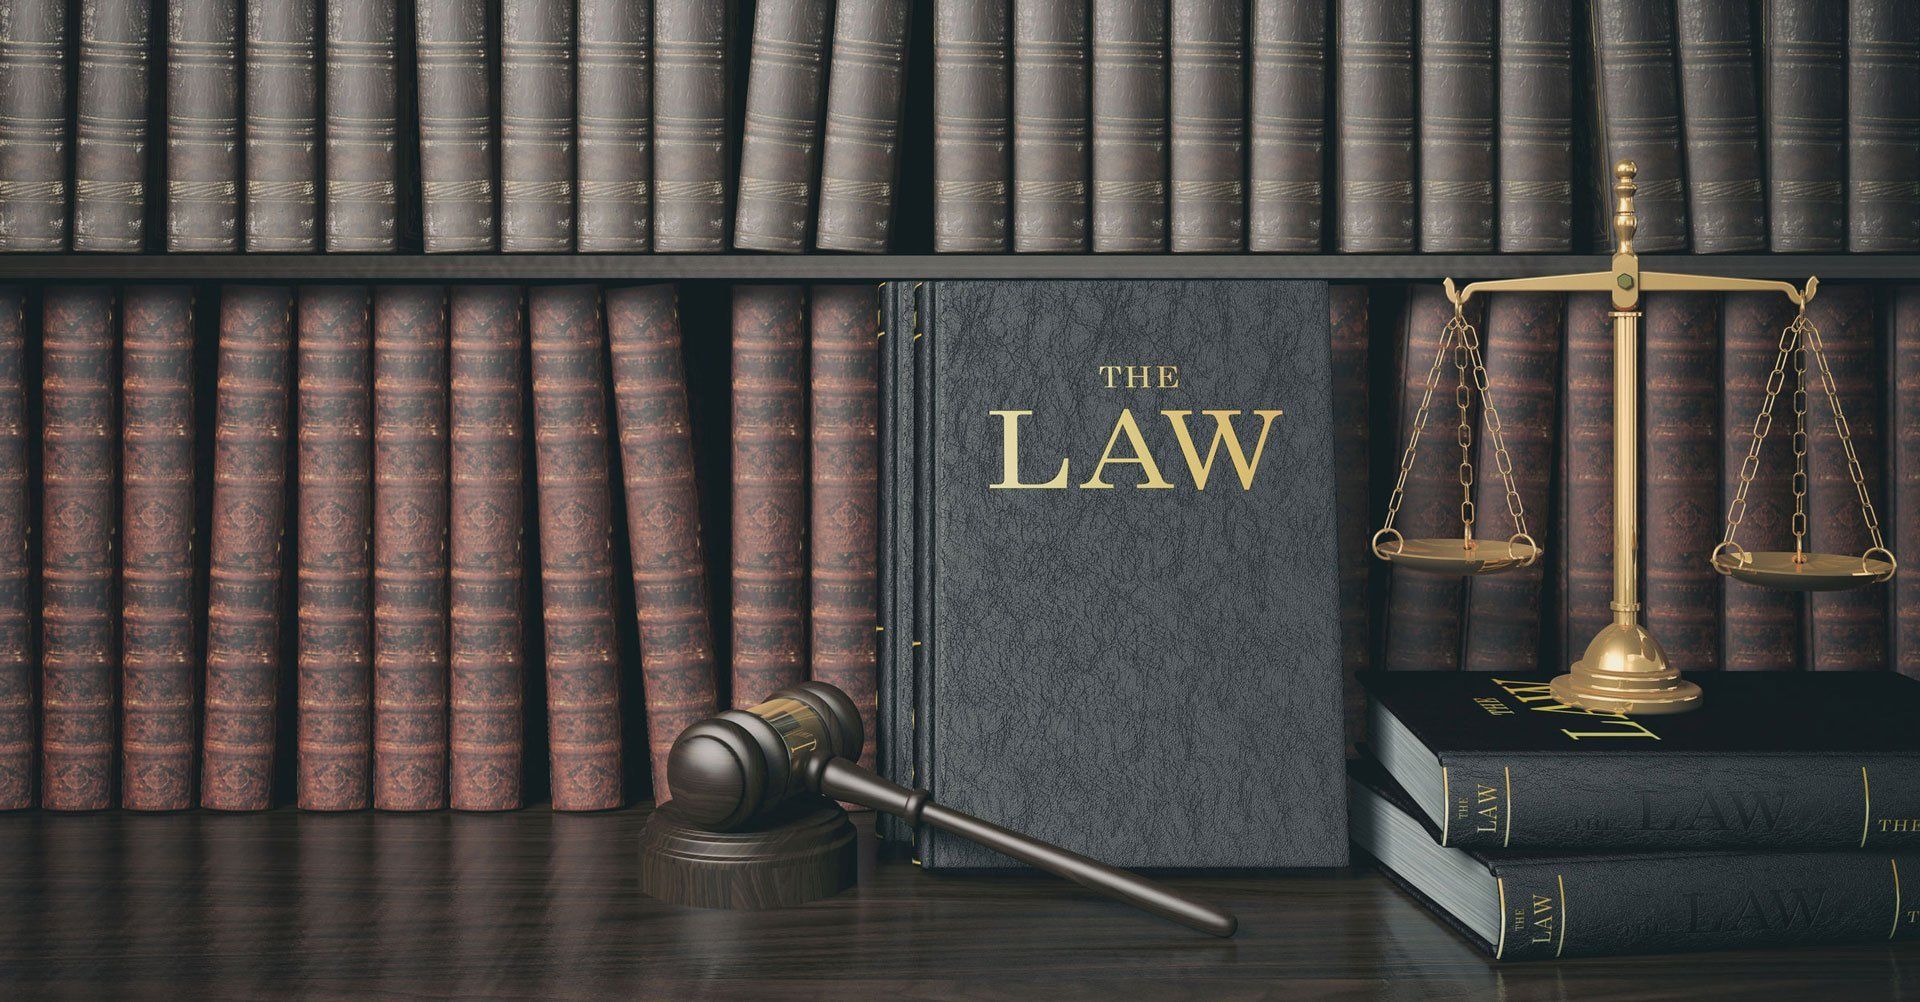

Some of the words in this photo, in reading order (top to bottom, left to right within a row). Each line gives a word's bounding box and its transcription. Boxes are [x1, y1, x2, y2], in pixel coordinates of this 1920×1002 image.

[1099, 365, 1180, 389] THE
[989, 408, 1283, 491] LAW
[1458, 797, 1469, 820] THE
[1477, 783, 1498, 833] LAW
[1878, 819, 1920, 832] THE
[1515, 908, 1525, 932] THE
[1533, 894, 1553, 944] LAW
